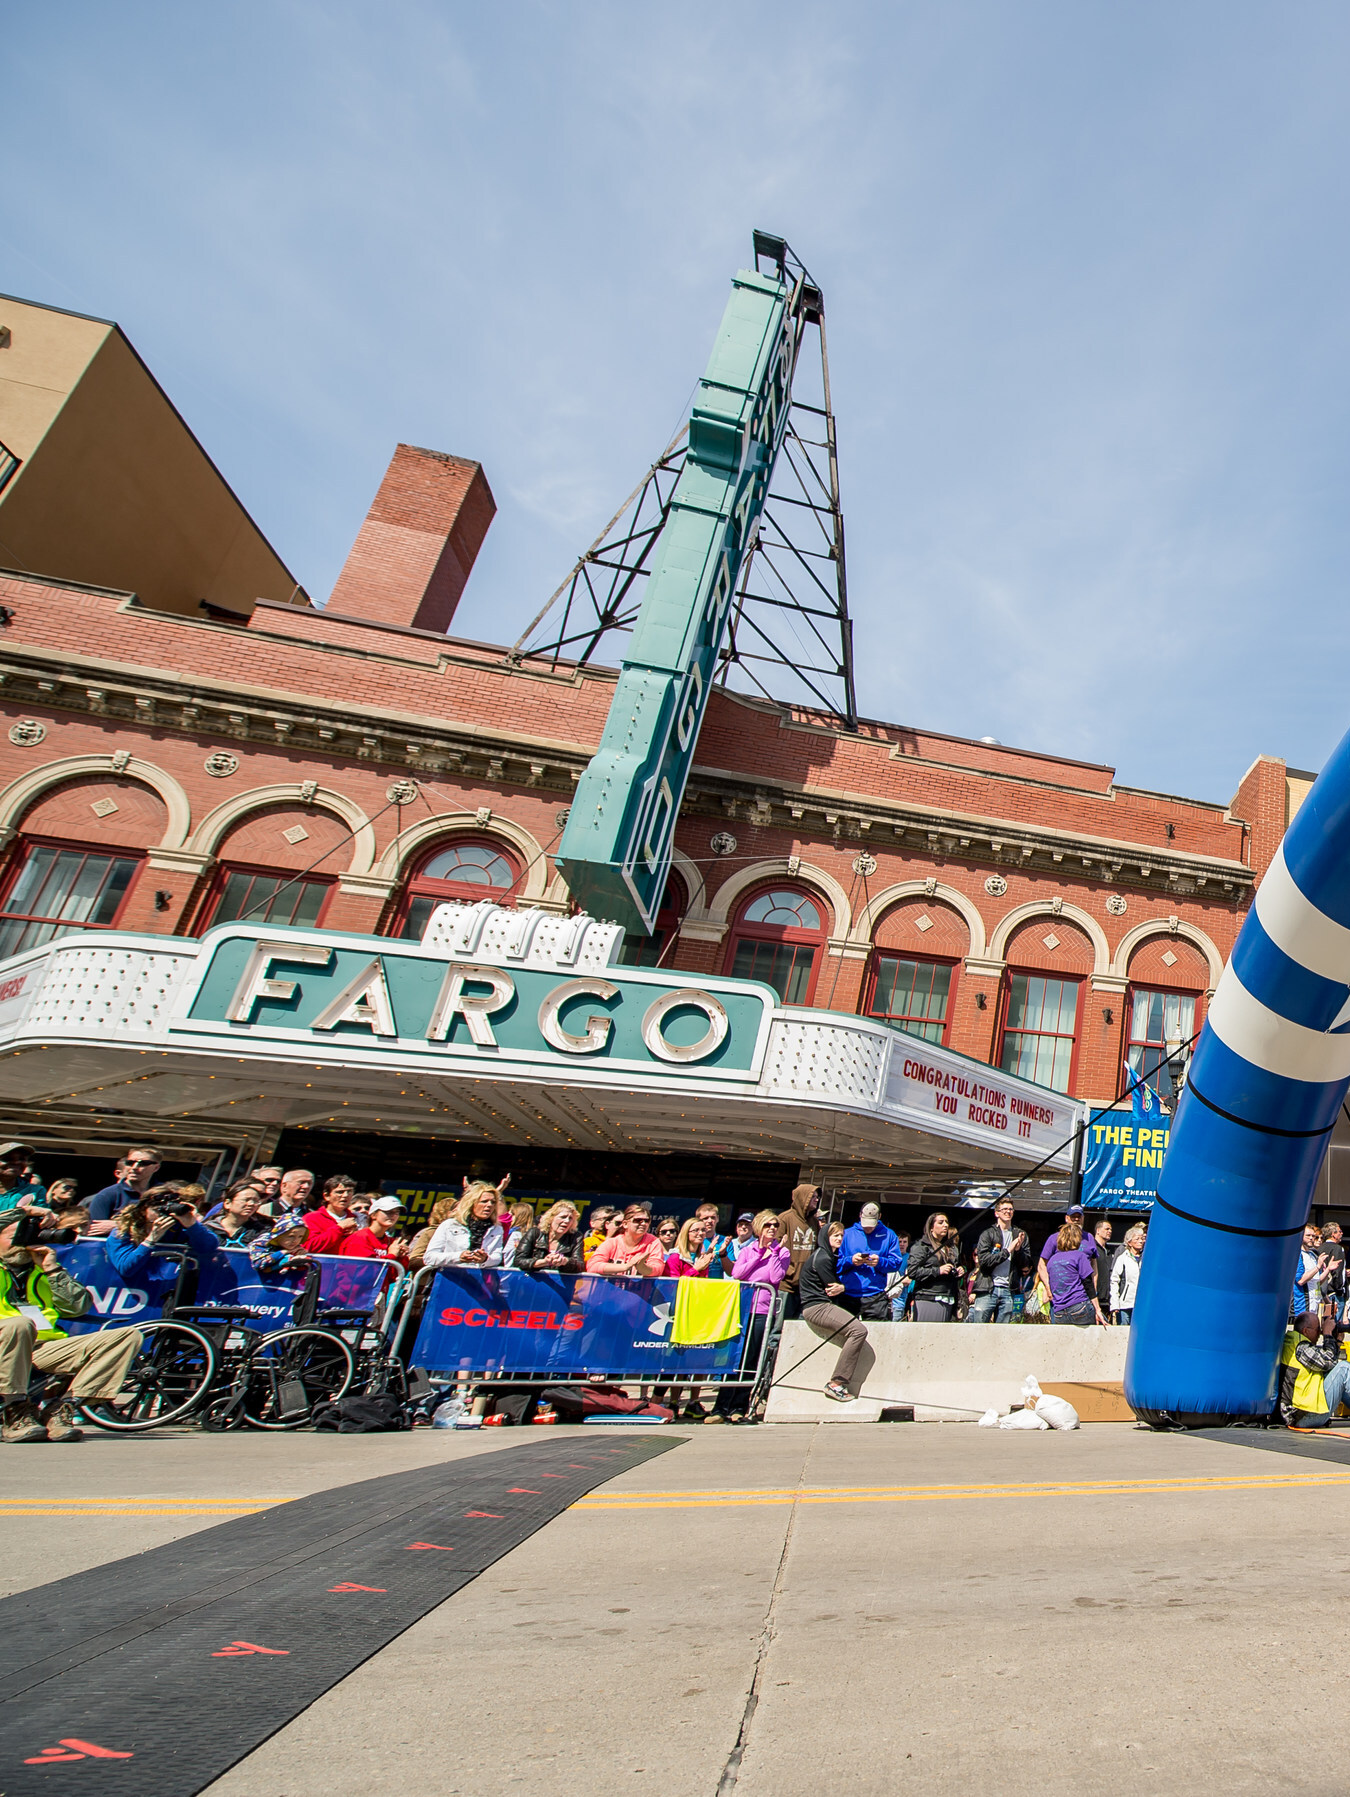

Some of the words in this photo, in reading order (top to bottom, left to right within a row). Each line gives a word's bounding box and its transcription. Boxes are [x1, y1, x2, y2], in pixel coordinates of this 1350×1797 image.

[225, 940, 730, 1063] FARGO
[903, 1059, 1006, 1109] CONGRATULATIONS
[1010, 1097, 1054, 1126] RUNNERS!
[935, 1091, 958, 1115] YOU
[968, 1103, 1008, 1130] ROCKED
[1018, 1120, 1031, 1138] IT!
[1092, 1124, 1133, 1146] THE
[1122, 1147, 1165, 1169] FINI
[1099, 1187, 1124, 1196] FARGO
[203, 1300, 286, 1319] Dovery
[438, 1307, 586, 1331] SCHEELS
